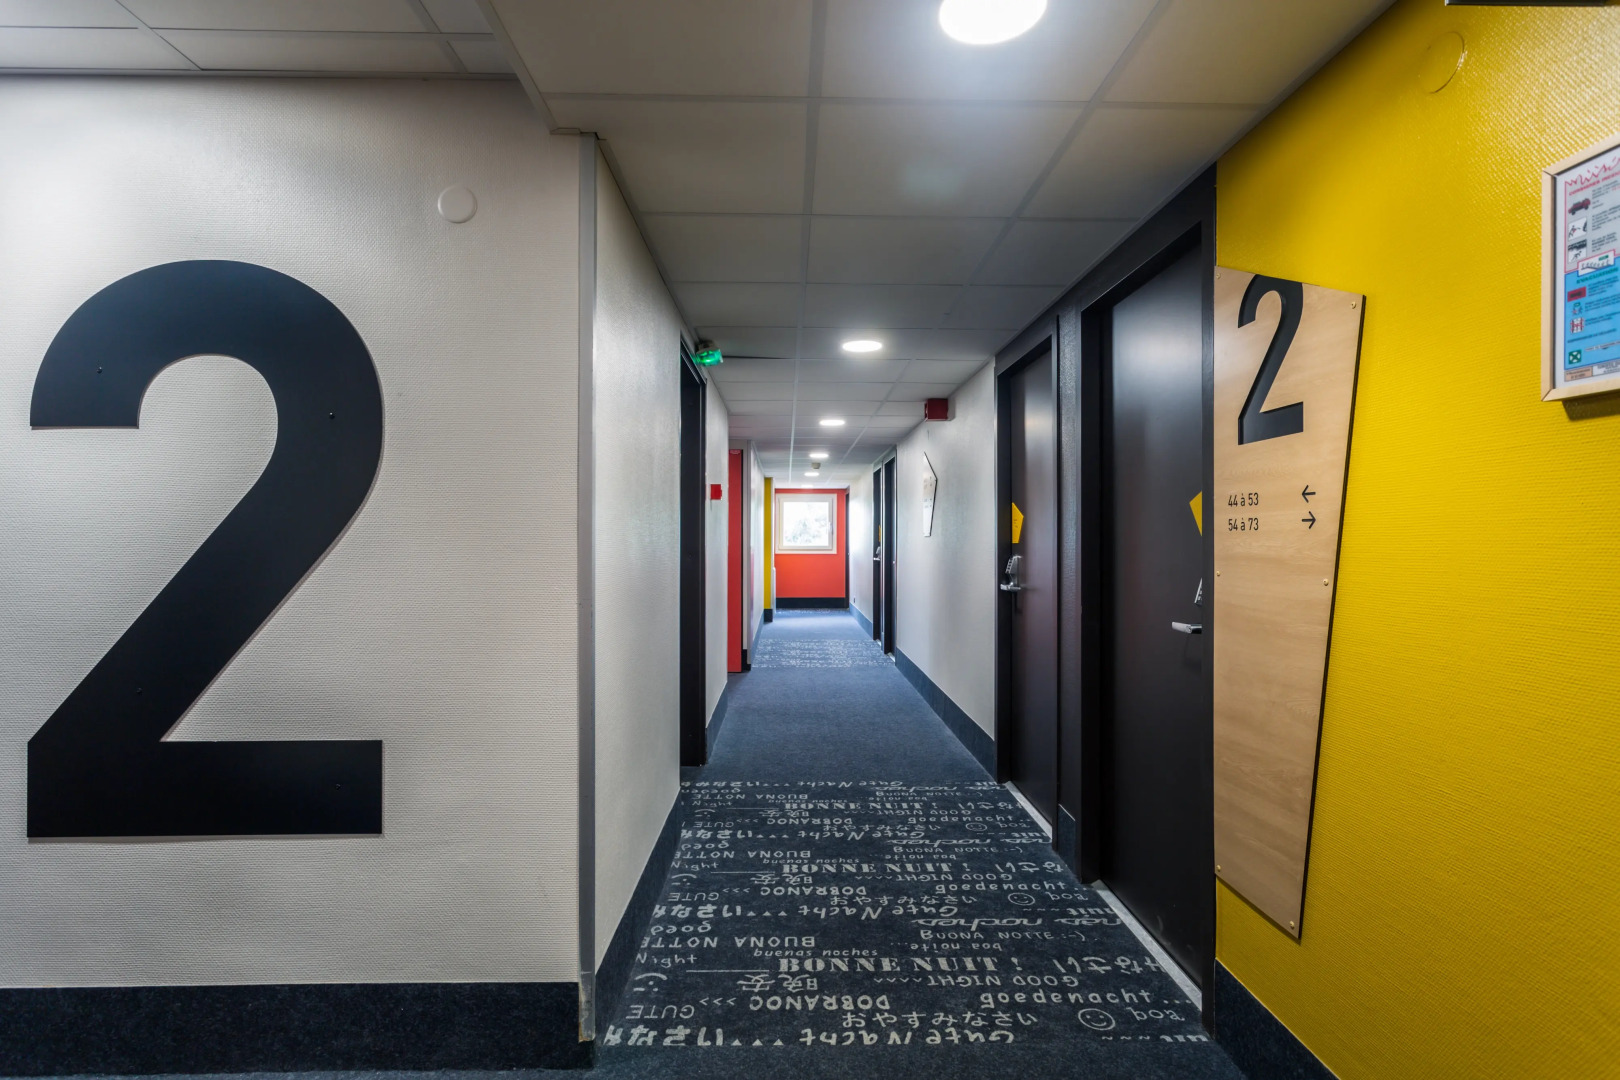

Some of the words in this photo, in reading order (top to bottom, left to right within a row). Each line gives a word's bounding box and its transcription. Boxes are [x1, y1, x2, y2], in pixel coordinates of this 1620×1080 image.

[1238, 274, 1303, 445] 2
[1228, 495, 1239, 507] 44
[1240, 494, 1246, 506] à
[1248, 493, 1259, 506] 53
[1228, 519, 1239, 531] 54
[1240, 518, 1246, 531] à
[1248, 518, 1259, 531] 73
[29, 260, 383, 836] 2
[798, 831, 864, 840] Nacht
[872, 830, 925, 838] Gute
[671, 861, 719, 871] Night
[783, 863, 876, 873] BONNE
[884, 863, 951, 872] NUIT
[760, 886, 866, 896] DOBRANOC
[935, 881, 1066, 894] goedenacht
[668, 892, 719, 901] GUTE
[798, 905, 882, 920] Nacht
[892, 904, 958, 917] Gute
[912, 918, 1042, 931] noches
[920, 930, 984, 940] BUONA
[998, 931, 1054, 939] NOTTE
[640, 937, 718, 948] NOTTE
[734, 936, 815, 948] BUONA
[972, 943, 1002, 951] boa
[754, 948, 812, 956] buenas
[822, 948, 878, 956] noches
[636, 953, 698, 968] Night
[779, 957, 901, 972] BONNE
[910, 957, 998, 971] NUIT
[927, 975, 1001, 987] NIGHT
[1013, 975, 1079, 987] GOOD
[750, 995, 890, 1010] DOBRANOC
[980, 988, 1151, 1008] goedenacht
[626, 1004, 694, 1019] GUTE
